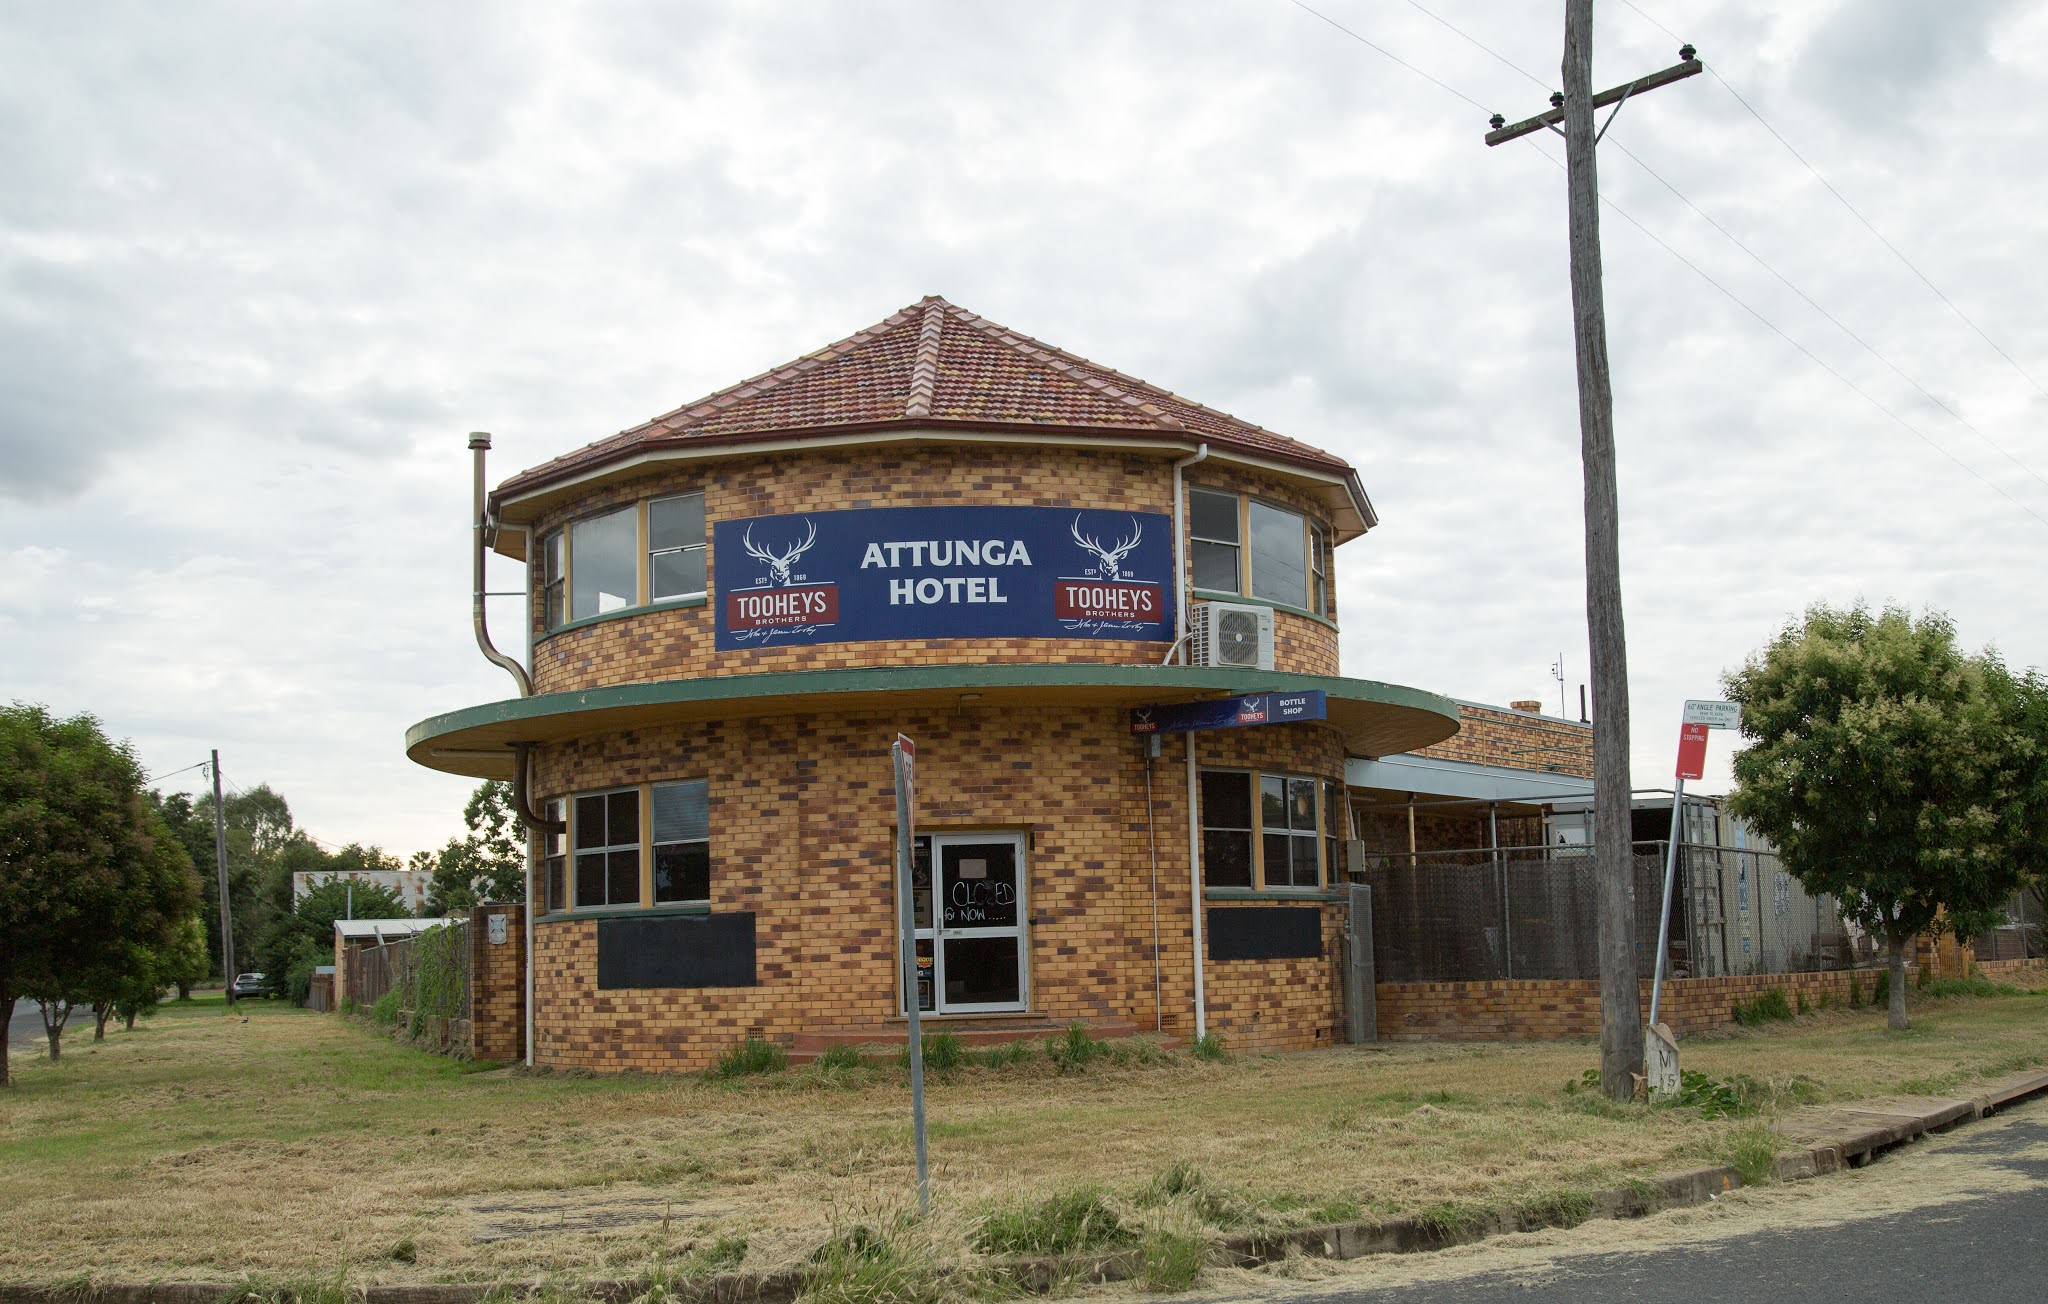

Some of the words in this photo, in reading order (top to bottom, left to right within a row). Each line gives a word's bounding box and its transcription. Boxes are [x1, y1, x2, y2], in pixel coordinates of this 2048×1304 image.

[860, 539, 1033, 569] ATTUNGA
[889, 577, 1008, 605] HOTEL
[1065, 586, 1153, 611] TOOHEYS
[737, 591, 827, 619] TOOHEYS
[755, 615, 807, 625] BROTHERS
[1085, 610, 1136, 618] BROTHERS
[1279, 697, 1306, 706] BOTTLE
[1241, 712, 1263, 720] TOOHEYS
[1283, 706, 1303, 715] SHOP
[1134, 722, 1155, 731] TOOHEYS
[944, 906, 955, 920] for
[1659, 1050, 1671, 1068] M
